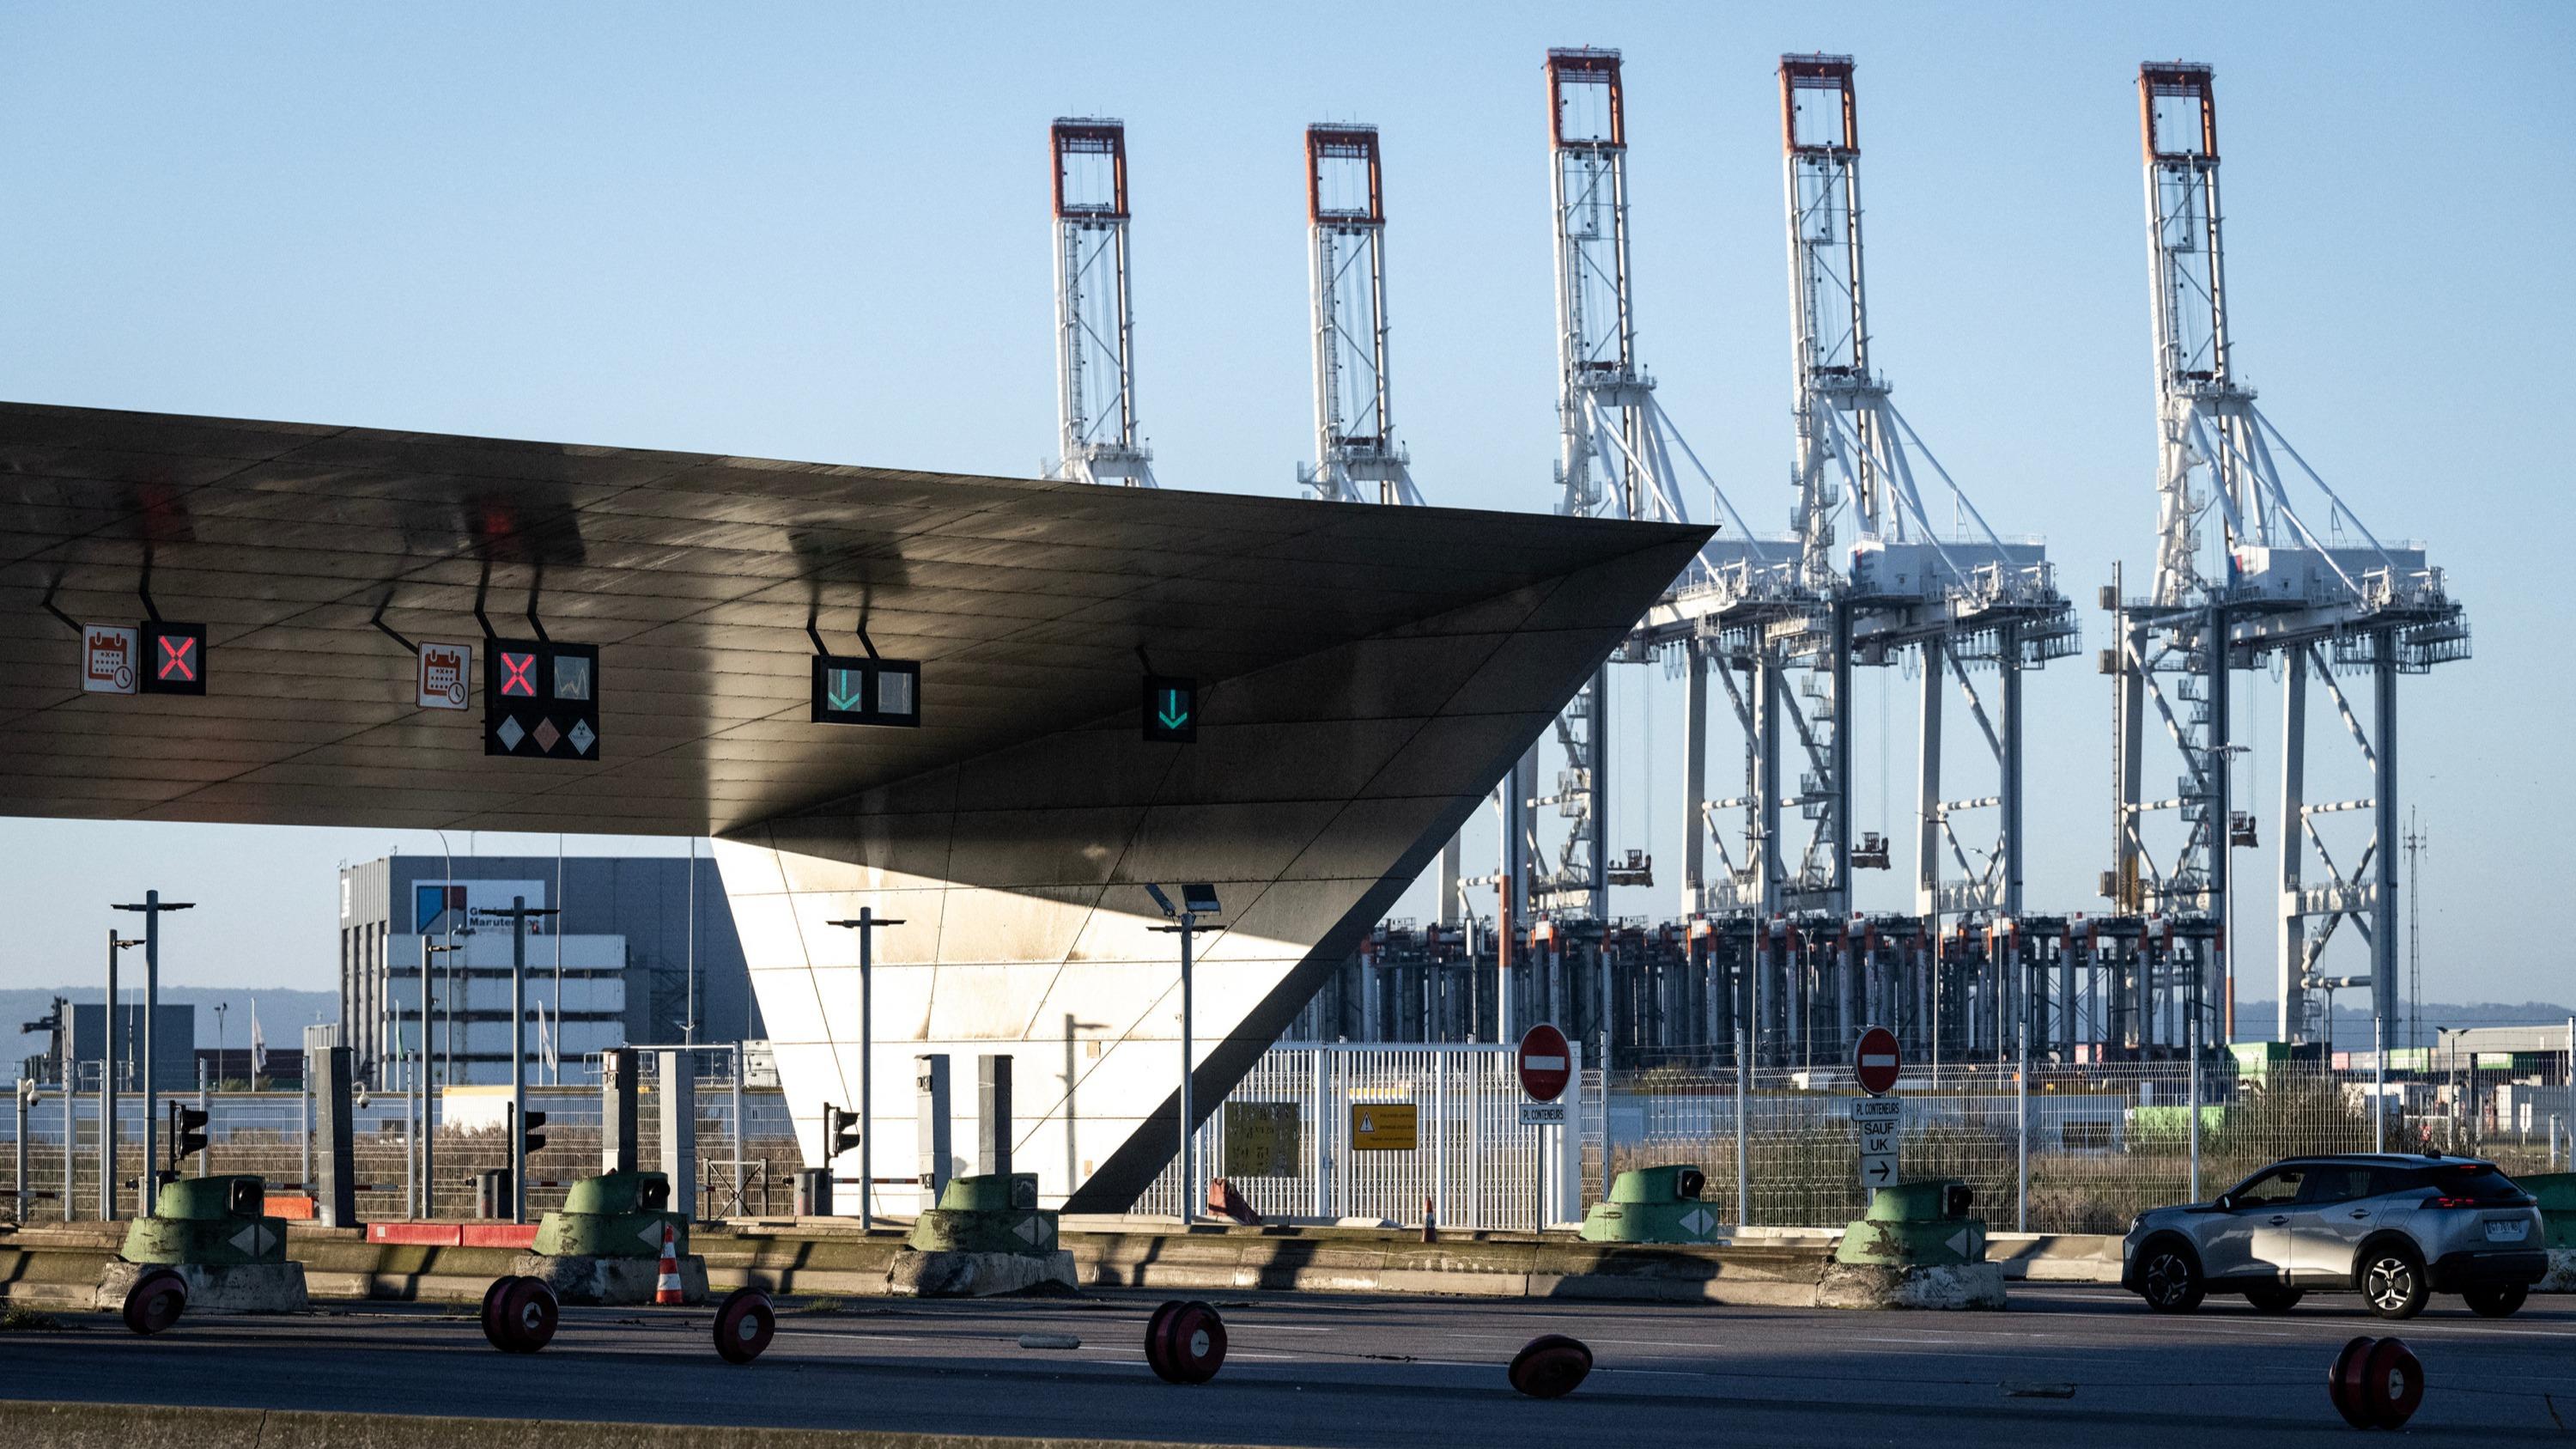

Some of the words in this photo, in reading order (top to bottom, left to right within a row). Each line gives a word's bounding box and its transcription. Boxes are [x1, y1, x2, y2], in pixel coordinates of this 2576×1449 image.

[1523, 1109, 1530, 1120] PL
[1531, 1109, 1564, 1120] CONTENEURS
[1856, 1103, 1863, 1115] PL
[1865, 1102, 1899, 1115] CONTENEURS
[1864, 1123, 1894, 1135] SAUF
[1870, 1138, 1888, 1151] UK
